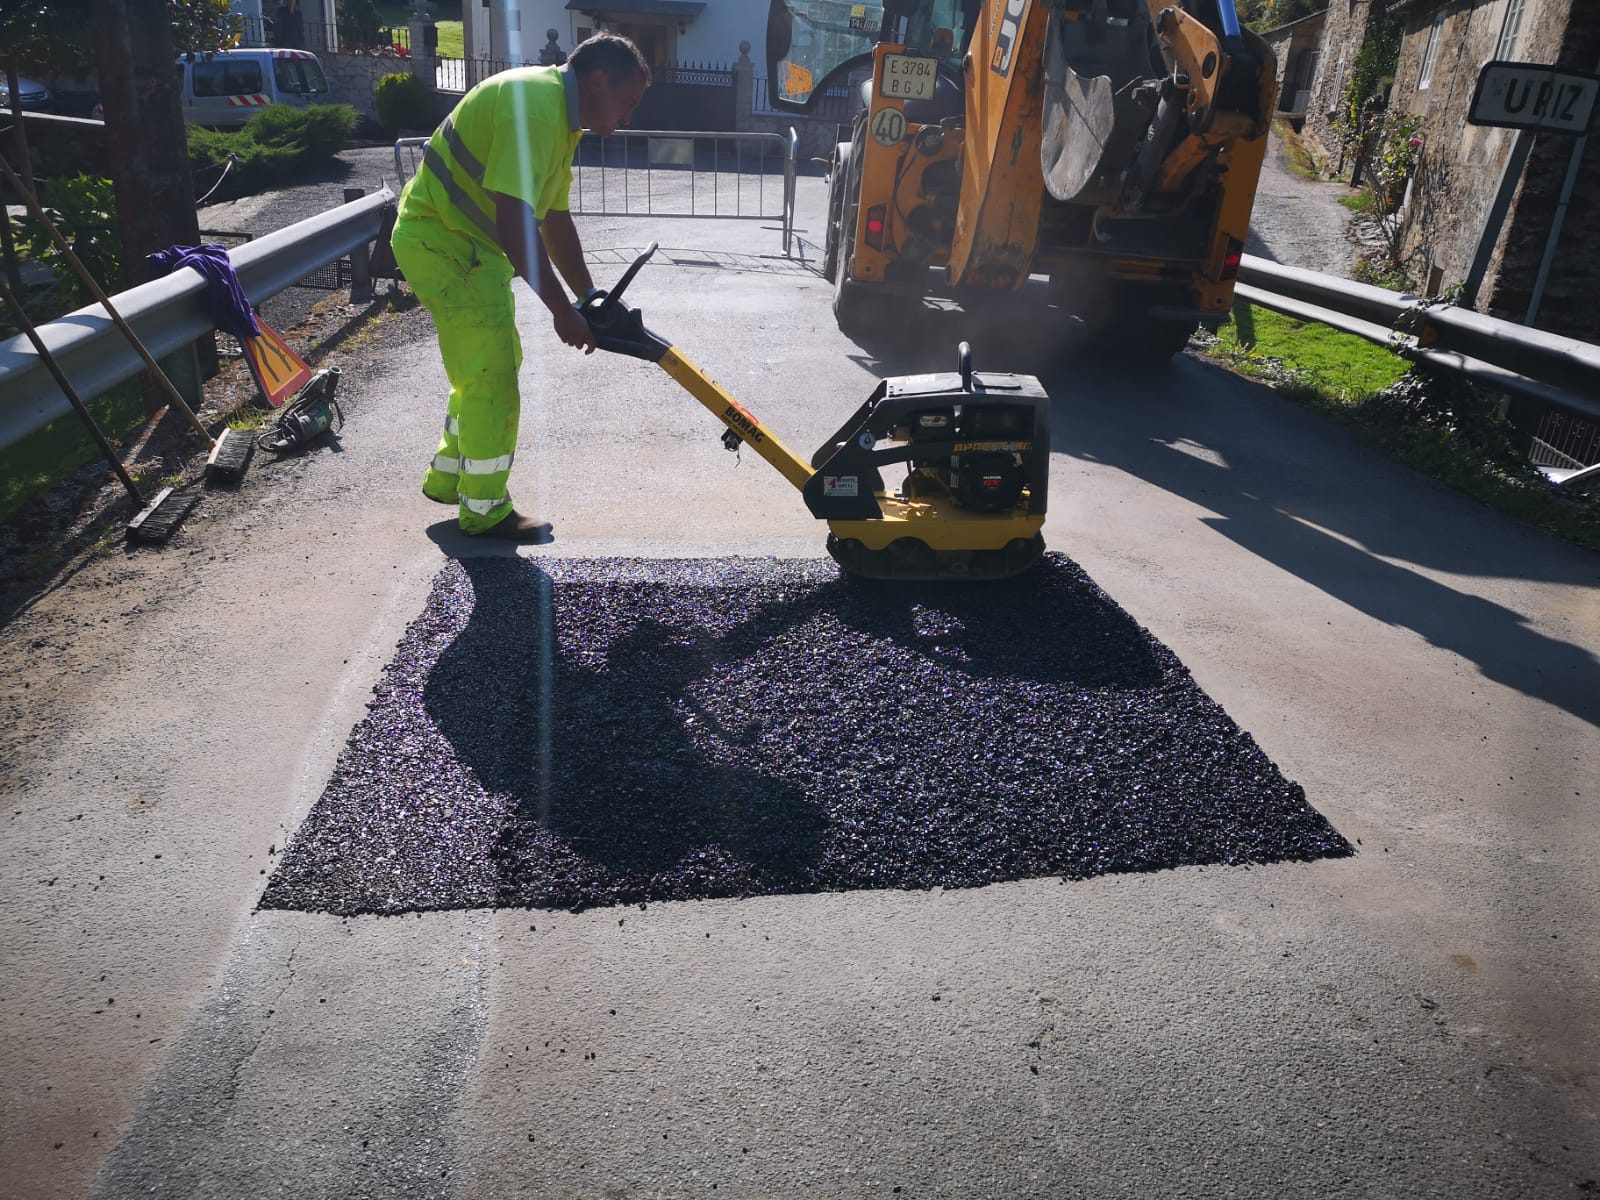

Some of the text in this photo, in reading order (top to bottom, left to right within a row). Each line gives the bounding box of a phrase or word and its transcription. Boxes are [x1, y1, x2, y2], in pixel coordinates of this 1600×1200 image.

[890, 60, 930, 77] E 3784
[1503, 78, 1584, 121] URIZ
[875, 112, 903, 142] 40
[725, 405, 765, 443] BOMAG
